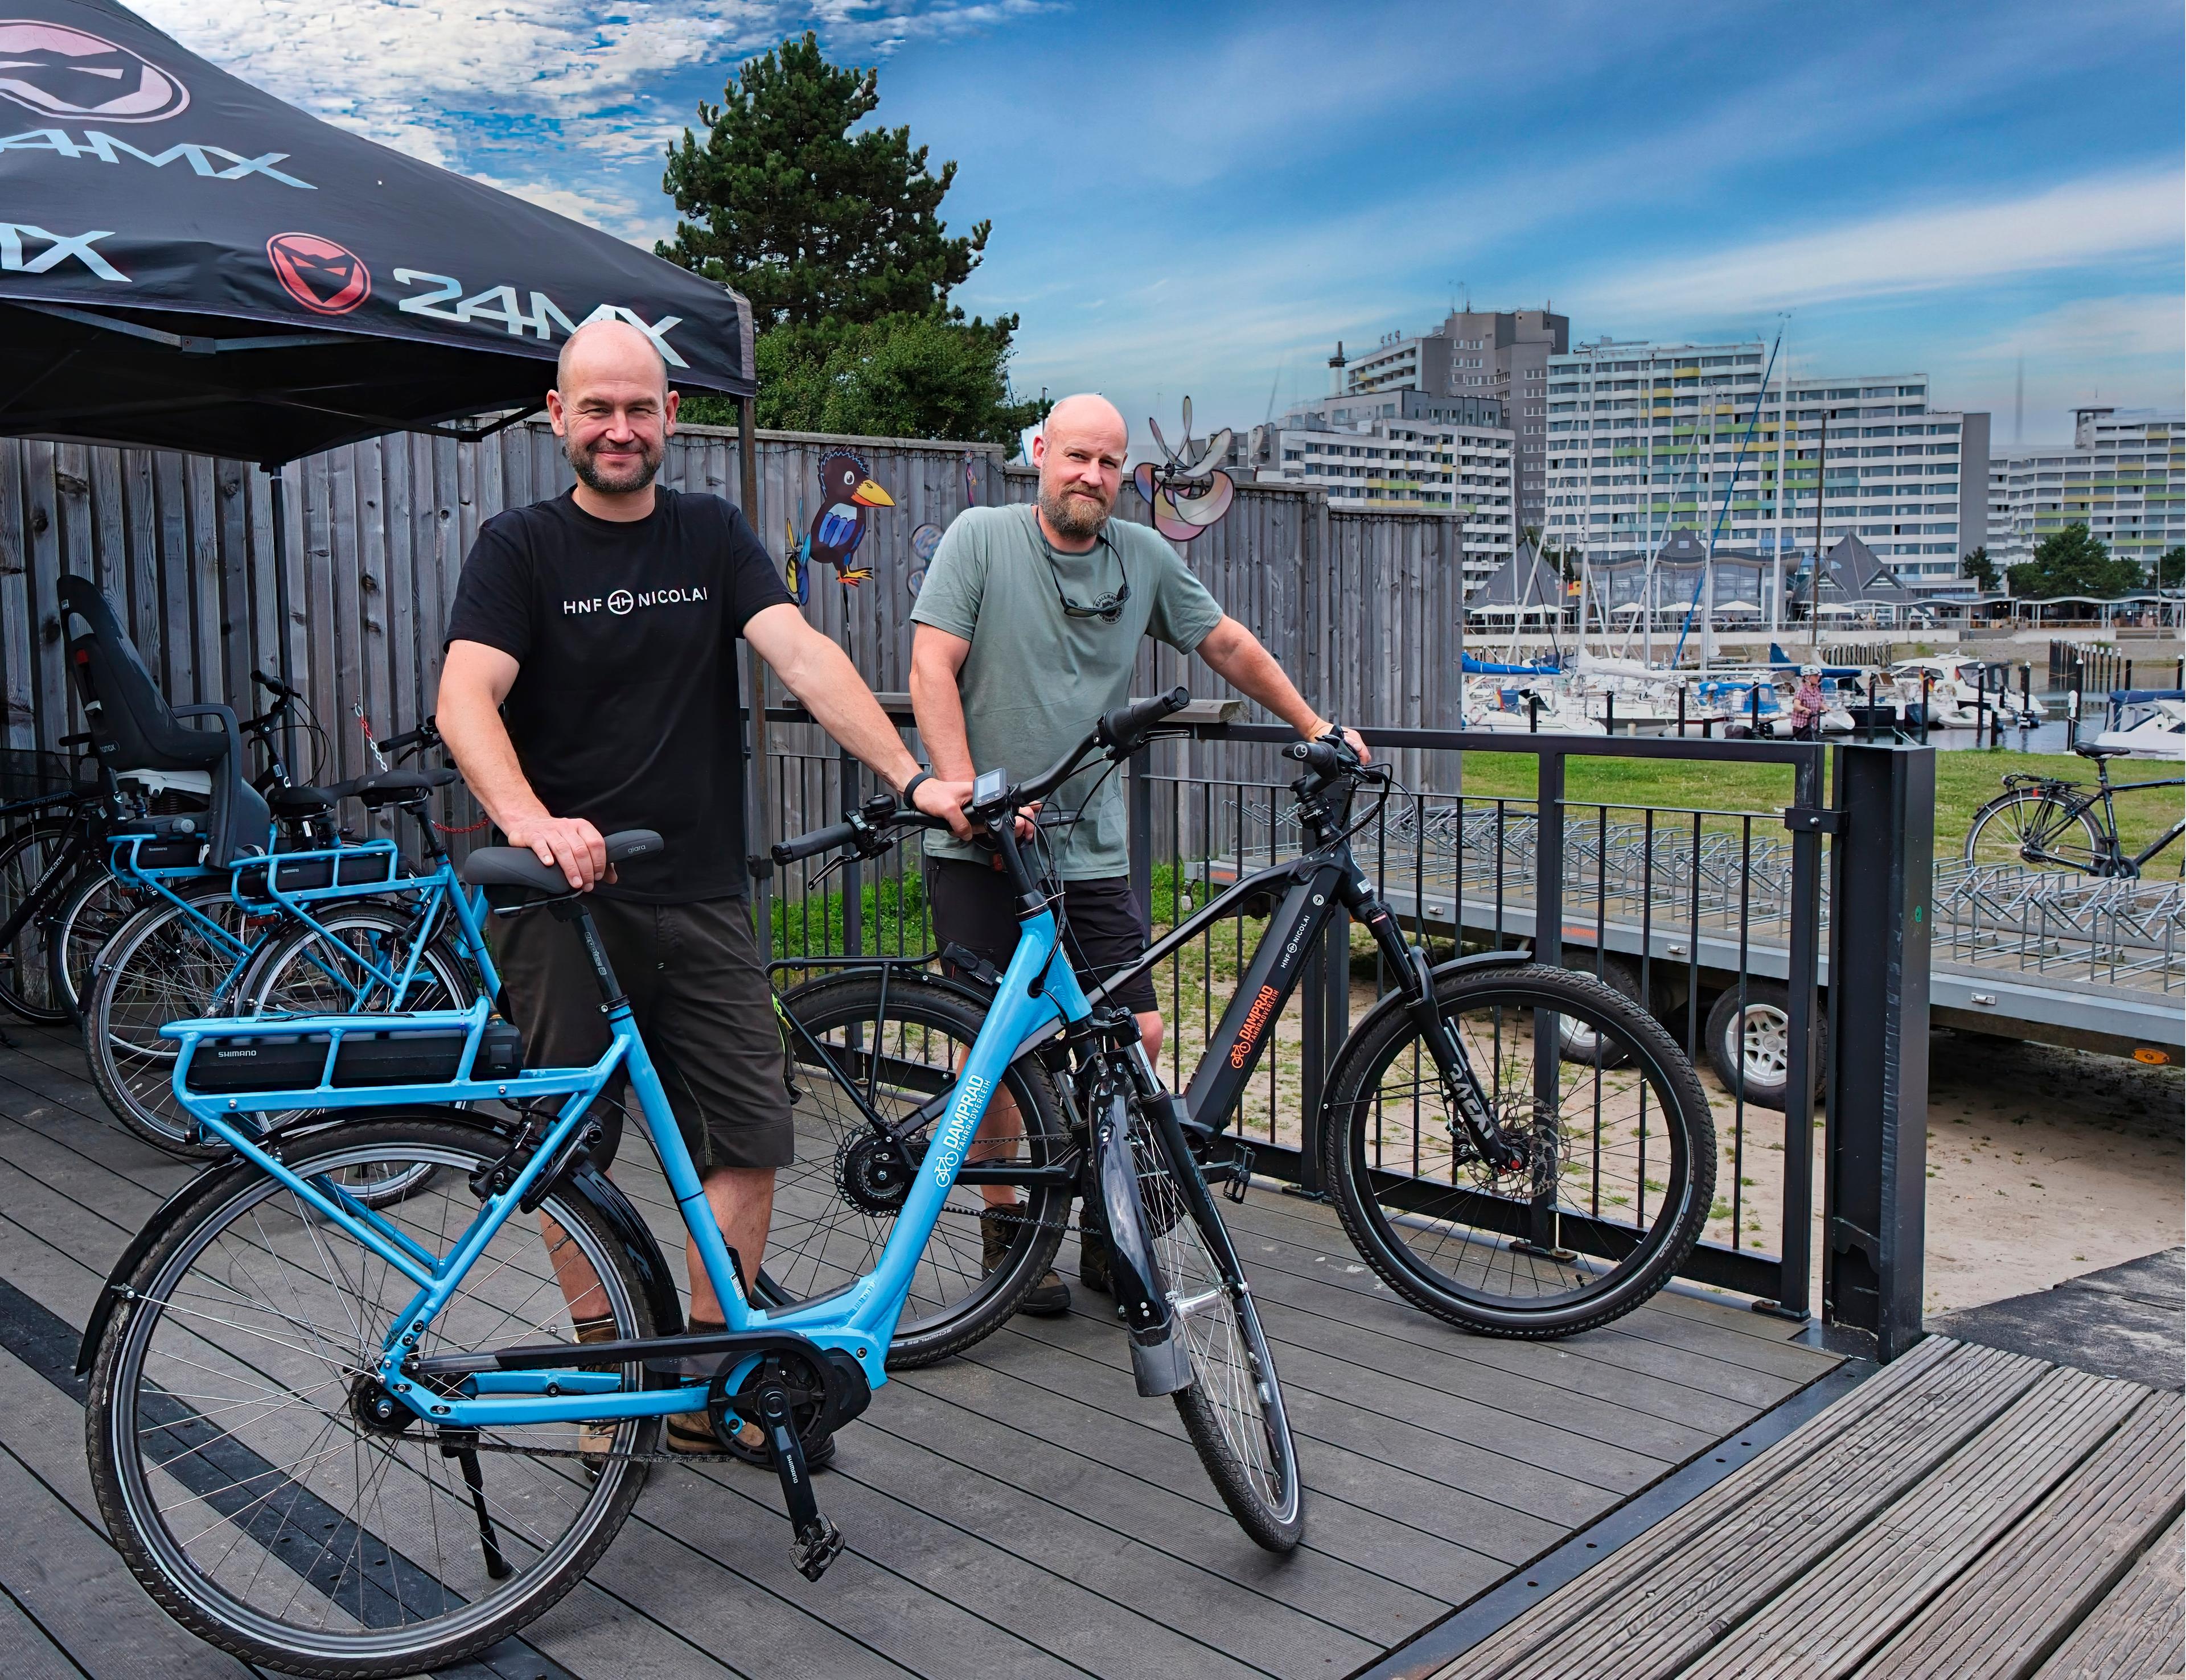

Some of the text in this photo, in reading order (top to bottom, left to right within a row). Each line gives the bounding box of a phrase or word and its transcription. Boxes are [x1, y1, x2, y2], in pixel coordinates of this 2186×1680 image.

[393, 267, 691, 369] 24MX
[564, 587, 708, 615] HNF NICOLAI
[628, 844, 646, 854] giara
[1280, 915, 1310, 969] HNF NICOLAI
[1239, 985, 1275, 1041] DAMPRAD
[1249, 989, 1280, 1044] FAHRRADVERLEIH
[942, 1074, 984, 1149] DAMPRAD
[956, 1080, 992, 1152] FAHRRADVERLEIH
[558, 1192, 611, 1250] CONTACT PLUS
[1658, 1240, 1674, 1258] TOUR
[907, 1327, 953, 1346] SCHWALBE
[786, 1454, 798, 1484] SHIMANO
